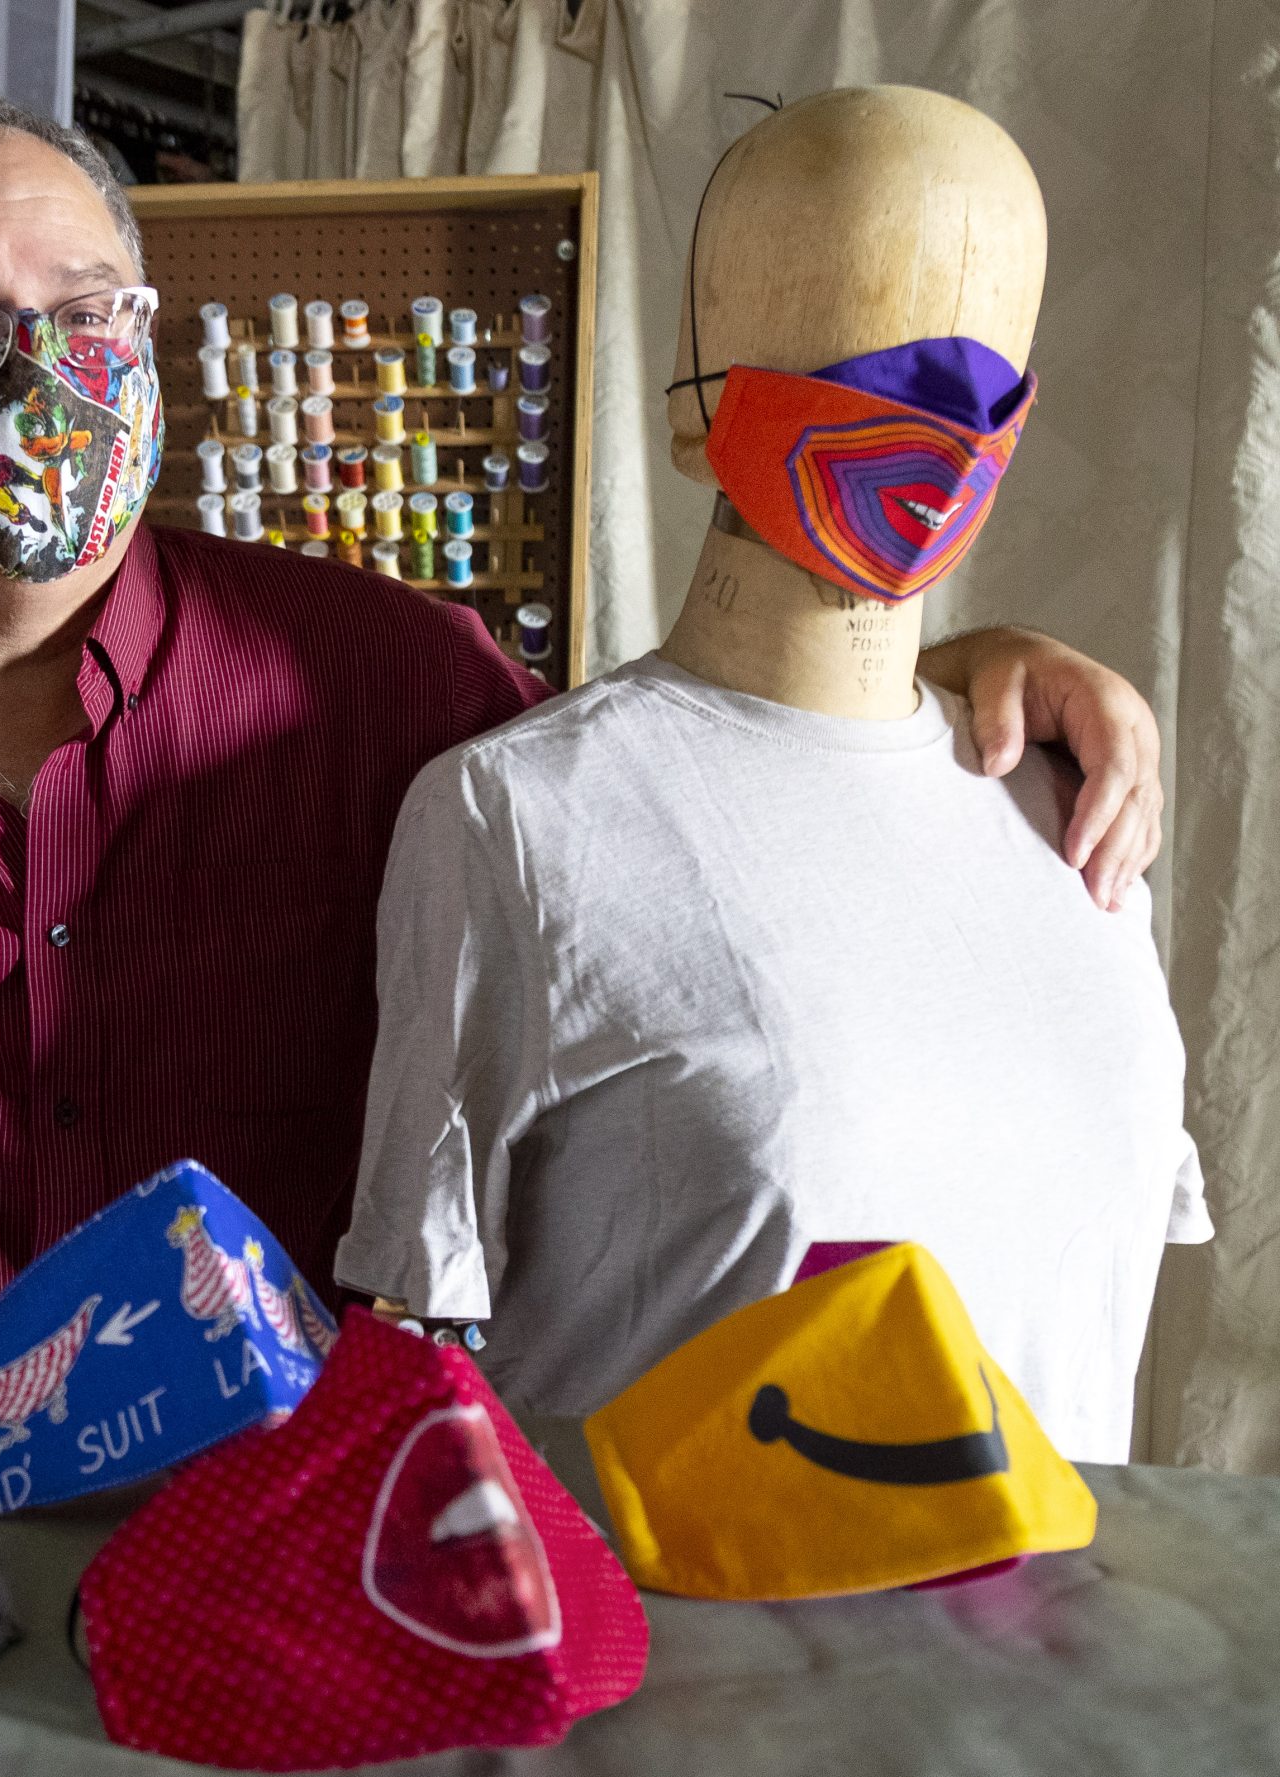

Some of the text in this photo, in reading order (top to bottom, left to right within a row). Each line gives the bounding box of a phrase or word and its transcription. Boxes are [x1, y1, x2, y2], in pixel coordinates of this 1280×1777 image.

[100, 484, 114, 514] AND
[108, 436, 127, 484] MEN!
[77, 1386, 168, 1475] SUIT
